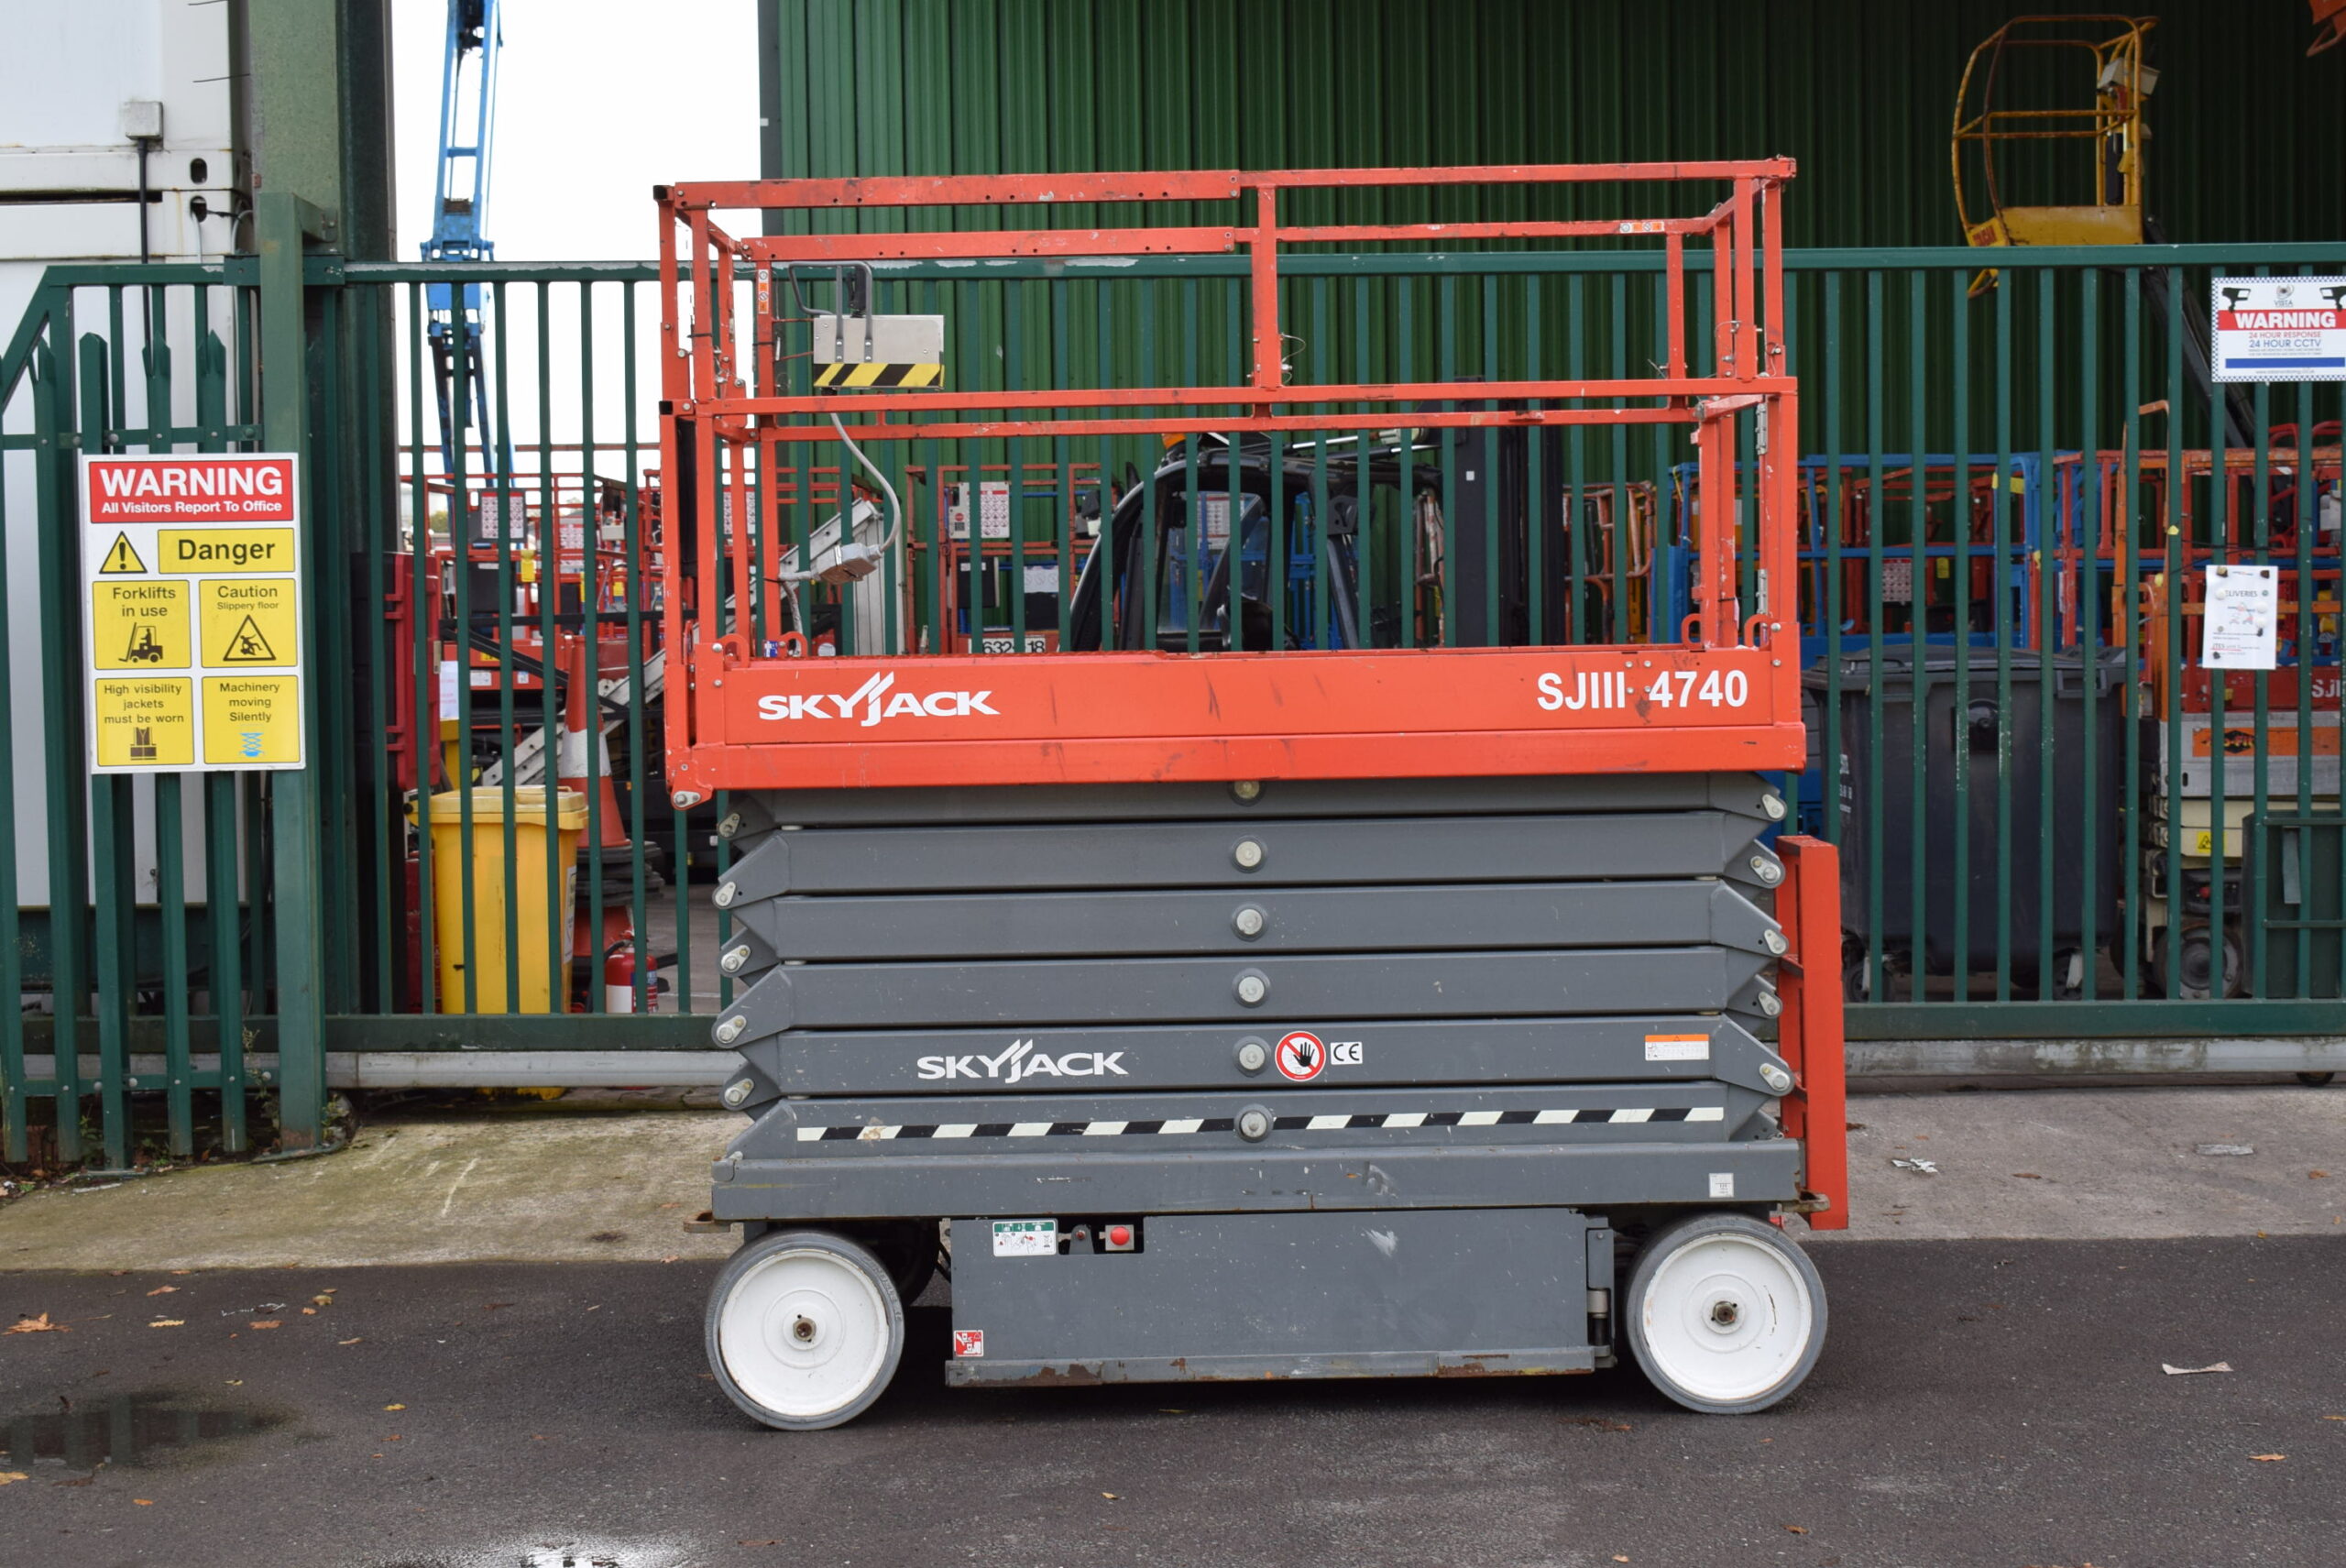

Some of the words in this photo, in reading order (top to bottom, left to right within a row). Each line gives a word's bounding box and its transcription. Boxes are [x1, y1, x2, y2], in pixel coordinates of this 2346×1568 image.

[2234, 312, 2337, 329] WARNING
[2249, 340, 2261, 348] 24
[2264, 339, 2291, 347] HOUR
[2294, 339, 2321, 347] CCTV
[99, 466, 283, 497] WARNING
[102, 502, 118, 513] All
[122, 501, 171, 513] Visitors
[175, 501, 221, 516] Report
[224, 501, 240, 512] To
[242, 500, 282, 512] Office
[178, 539, 275, 565] Danger
[112, 587, 176, 600] Forklifts
[217, 586, 279, 598] Caution
[2224, 589, 2258, 598] ELIVERIES
[122, 606, 135, 618] in
[140, 607, 168, 618] use
[216, 601, 255, 611] Slippery
[258, 601, 279, 609] floor
[104, 684, 129, 696] High
[134, 683, 182, 696] visibility
[220, 682, 280, 694] Machinery
[1537, 672, 1626, 710] SJIII
[1649, 670, 1749, 708] 4740
[123, 698, 164, 711] jackets
[229, 697, 271, 708] moving
[757, 671, 1002, 727] SKYJACK
[104, 714, 133, 724] must
[137, 713, 151, 723] be
[155, 714, 184, 723] worn
[229, 711, 272, 723] Silently
[1333, 1043, 1360, 1061] CE
[916, 1038, 1130, 1084] SKYJACK
